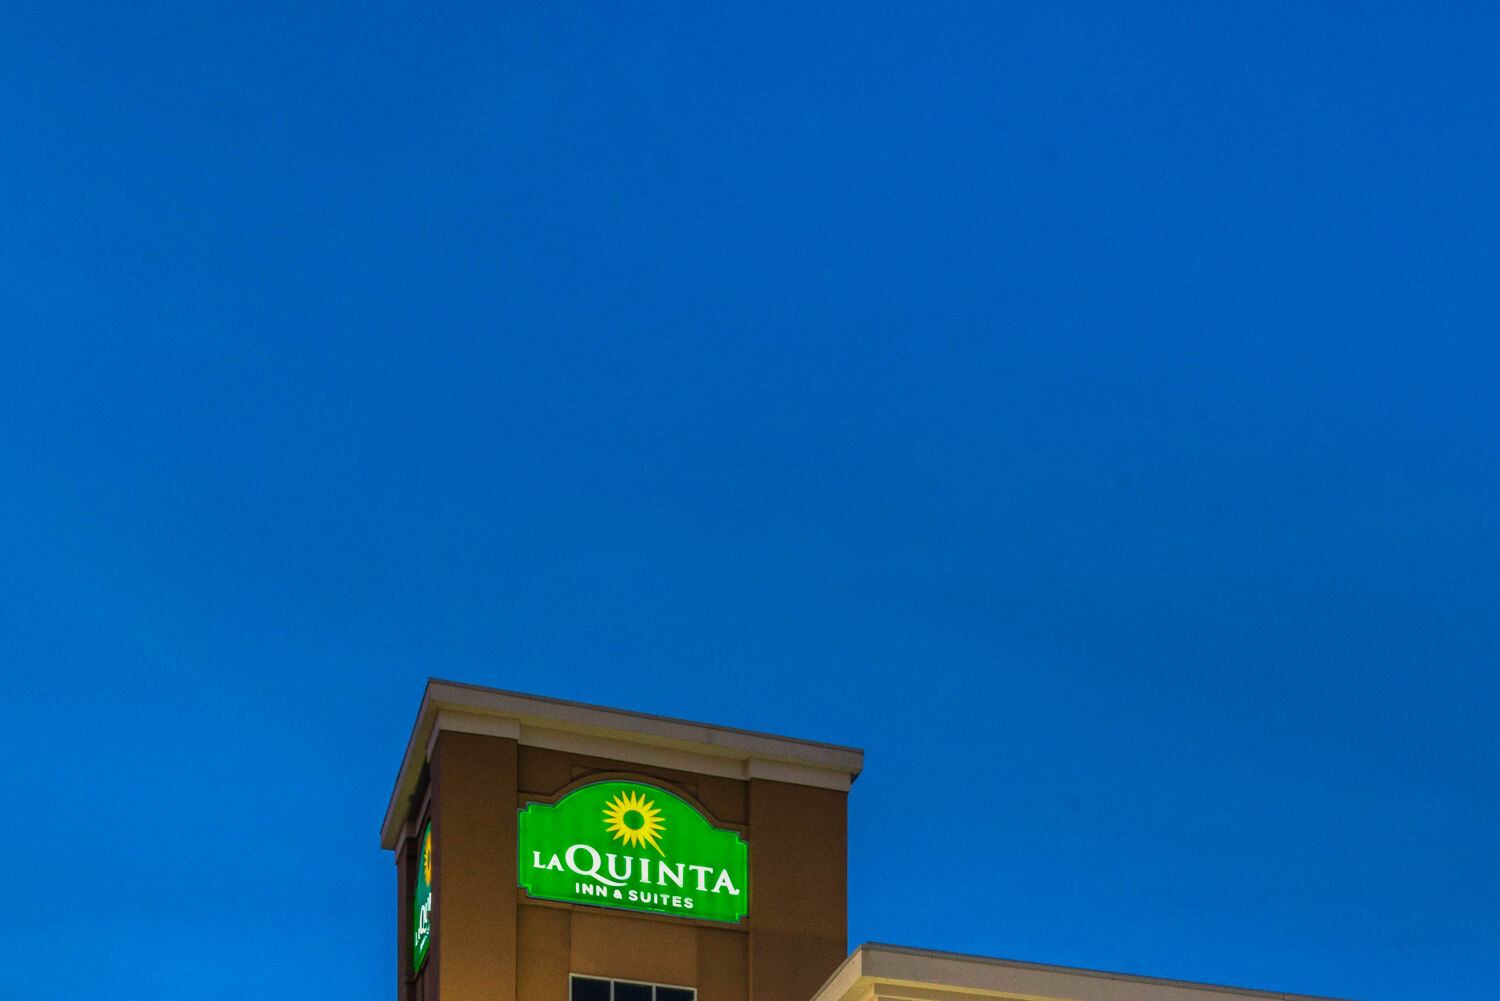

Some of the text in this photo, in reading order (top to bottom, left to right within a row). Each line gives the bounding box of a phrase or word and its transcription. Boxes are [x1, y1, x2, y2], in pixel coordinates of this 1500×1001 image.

[575, 882, 694, 909] INN & SUITES
